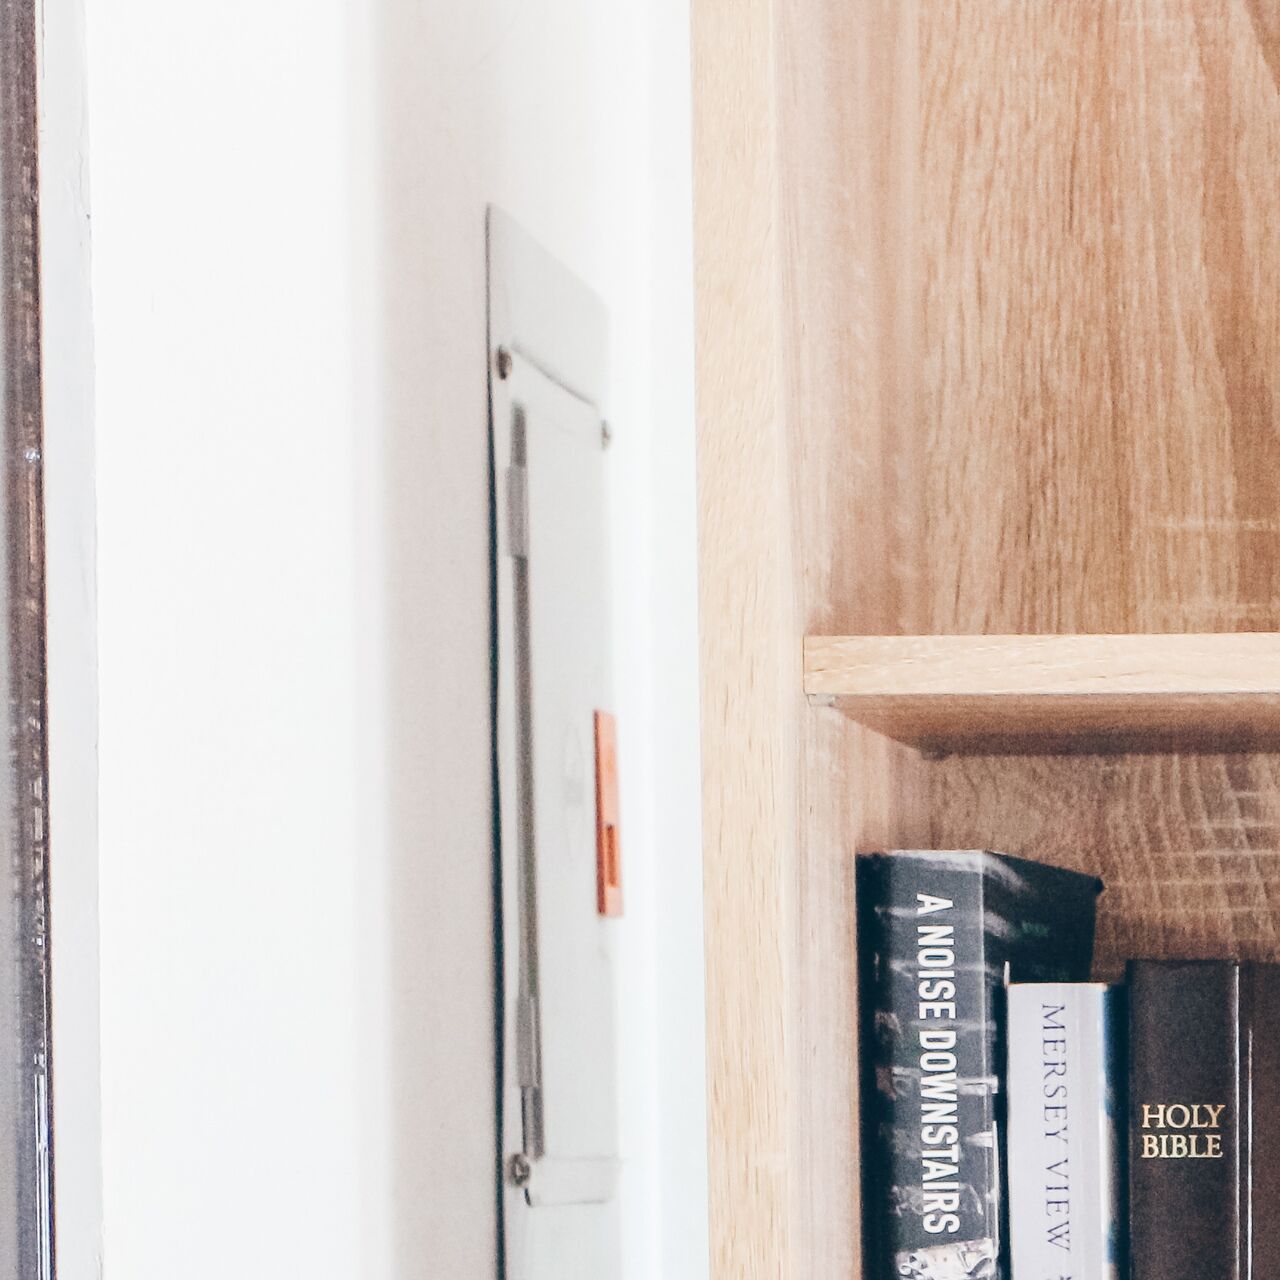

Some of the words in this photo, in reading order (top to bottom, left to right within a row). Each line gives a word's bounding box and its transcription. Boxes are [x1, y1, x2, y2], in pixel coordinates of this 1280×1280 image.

[916, 893, 954, 915] A
[917, 925, 956, 1020] NOISE
[1041, 1004, 1068, 1139] MERSEY
[1141, 1104, 1225, 1129] HOLY
[918, 1031, 961, 1235] DOWNSTAIRS
[1141, 1134, 1224, 1159] BIBLE
[1045, 1158, 1071, 1252] VIEW
